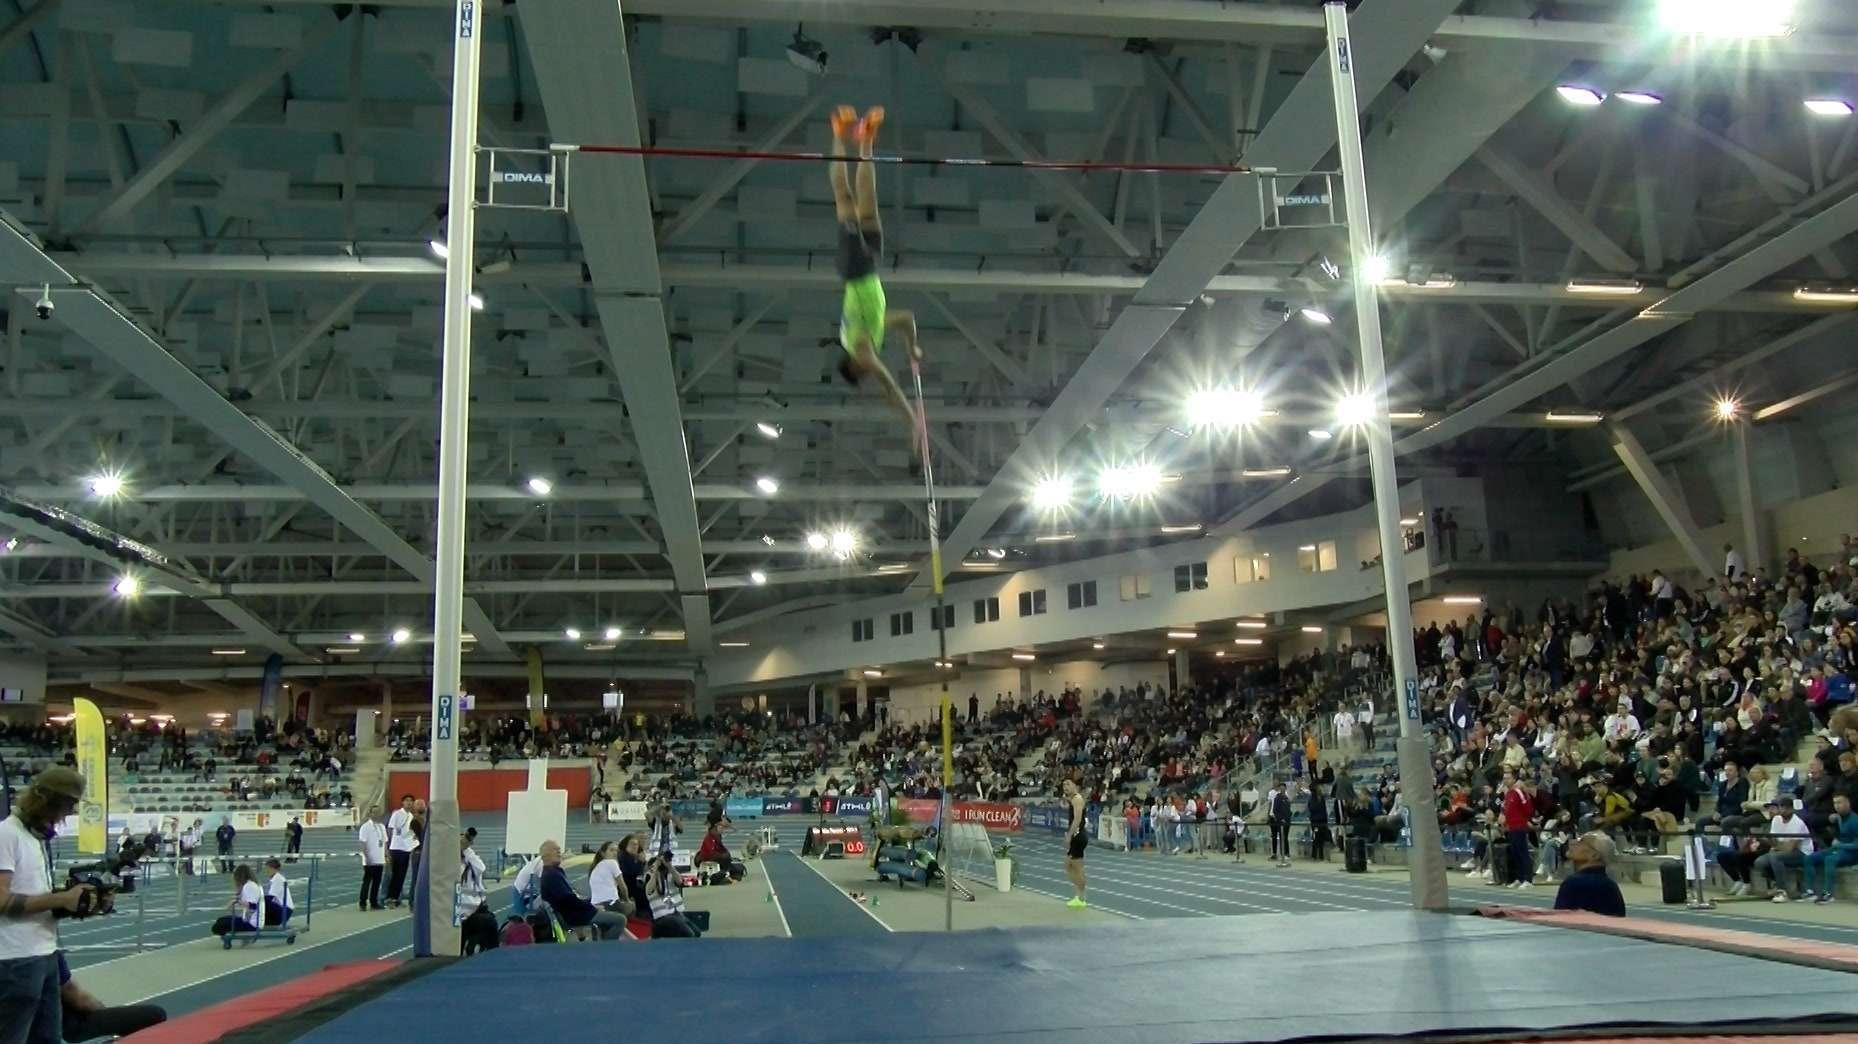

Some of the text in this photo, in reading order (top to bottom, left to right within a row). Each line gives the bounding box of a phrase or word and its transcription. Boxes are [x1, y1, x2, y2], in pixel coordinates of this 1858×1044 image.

[461, 2, 472, 37] DIMA
[504, 172, 544, 183] DIMA
[1285, 195, 1321, 205] DIMA
[1406, 681, 1418, 717] DIMA
[439, 697, 451, 739] DIMA
